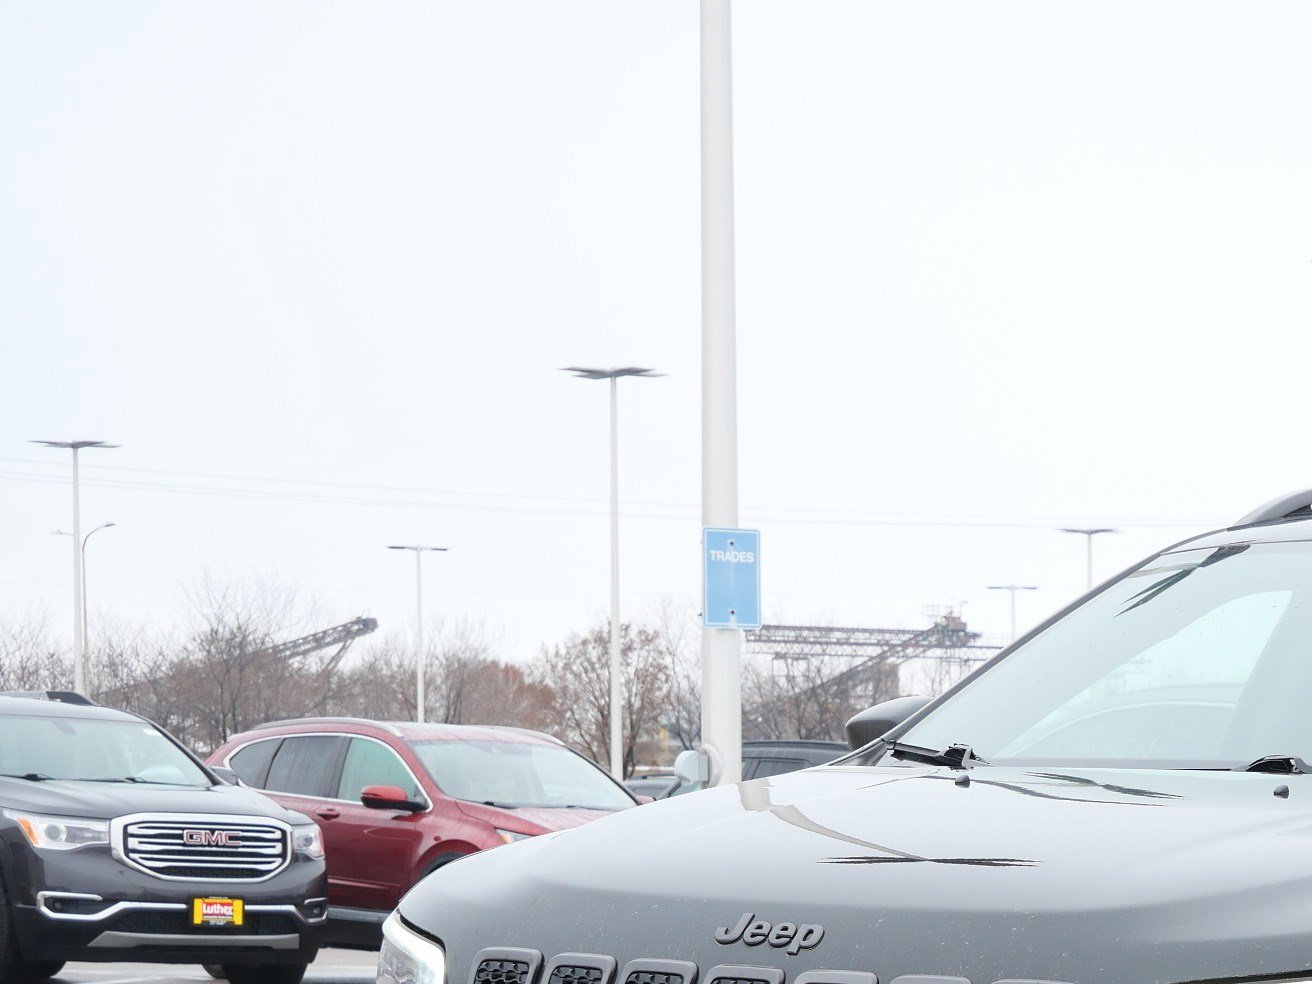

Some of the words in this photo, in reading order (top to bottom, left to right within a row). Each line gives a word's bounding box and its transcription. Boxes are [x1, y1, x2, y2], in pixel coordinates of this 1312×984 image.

[709, 550, 755, 563] TRADES
[183, 829, 242, 846] GMC
[203, 903, 233, 914] Luther
[715, 912, 825, 956] Jeep
